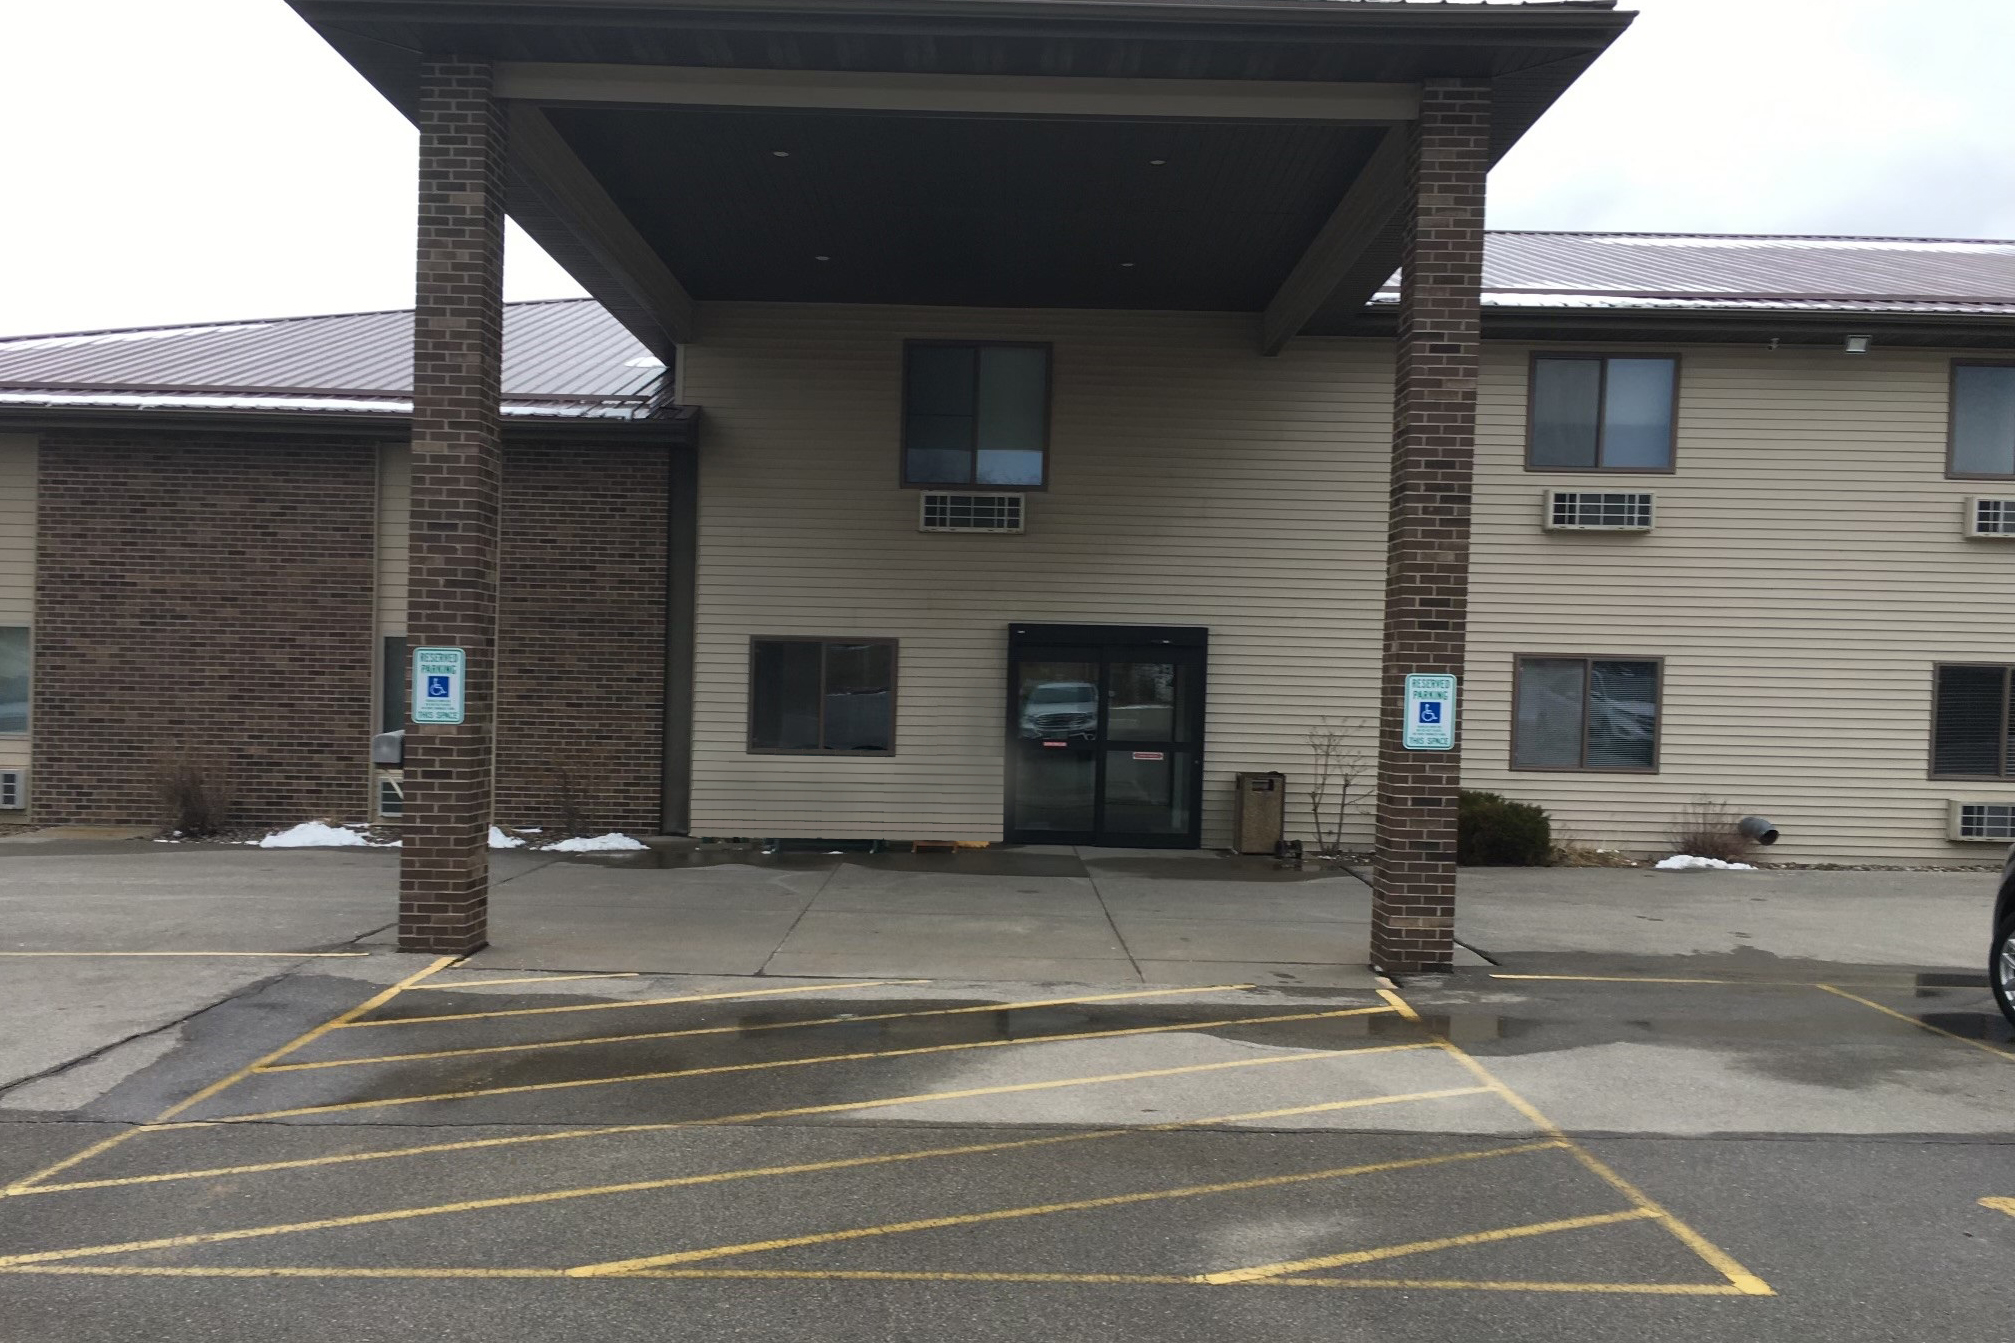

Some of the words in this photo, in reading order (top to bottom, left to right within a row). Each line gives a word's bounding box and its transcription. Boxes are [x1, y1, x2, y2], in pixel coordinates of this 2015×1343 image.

[420, 652, 457, 663] RESERVED
[421, 664, 456, 674] PARKING
[1412, 679, 1450, 689] RESERVED
[1413, 690, 1448, 700] PARKING
[418, 711, 433, 719] THIS
[436, 711, 458, 720] SPACE
[1408, 736, 1424, 745] THIS
[1427, 737, 1449, 745] SPACE
